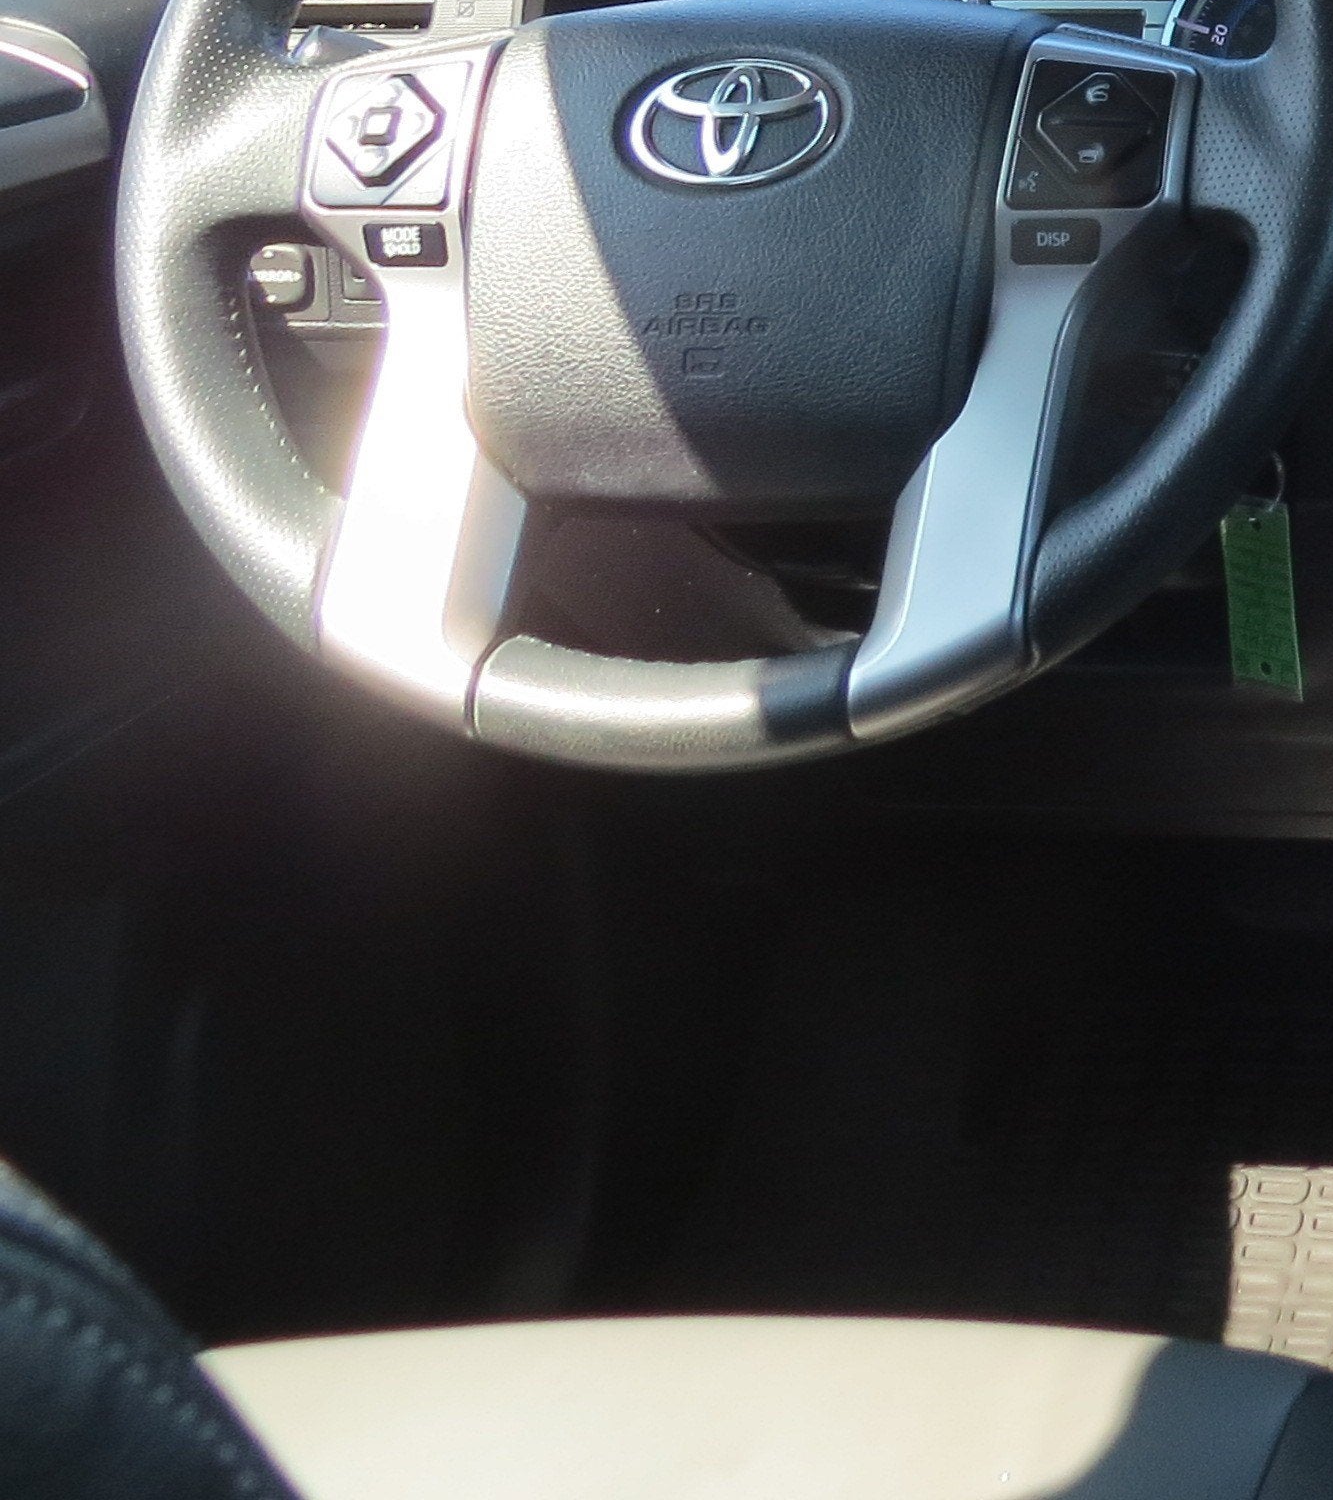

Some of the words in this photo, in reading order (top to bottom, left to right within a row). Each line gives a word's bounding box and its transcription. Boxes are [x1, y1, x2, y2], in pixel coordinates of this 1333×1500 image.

[1210, 23, 1229, 47] 20
[1036, 231, 1071, 247] DISP
[641, 315, 768, 338] AIRBAG
